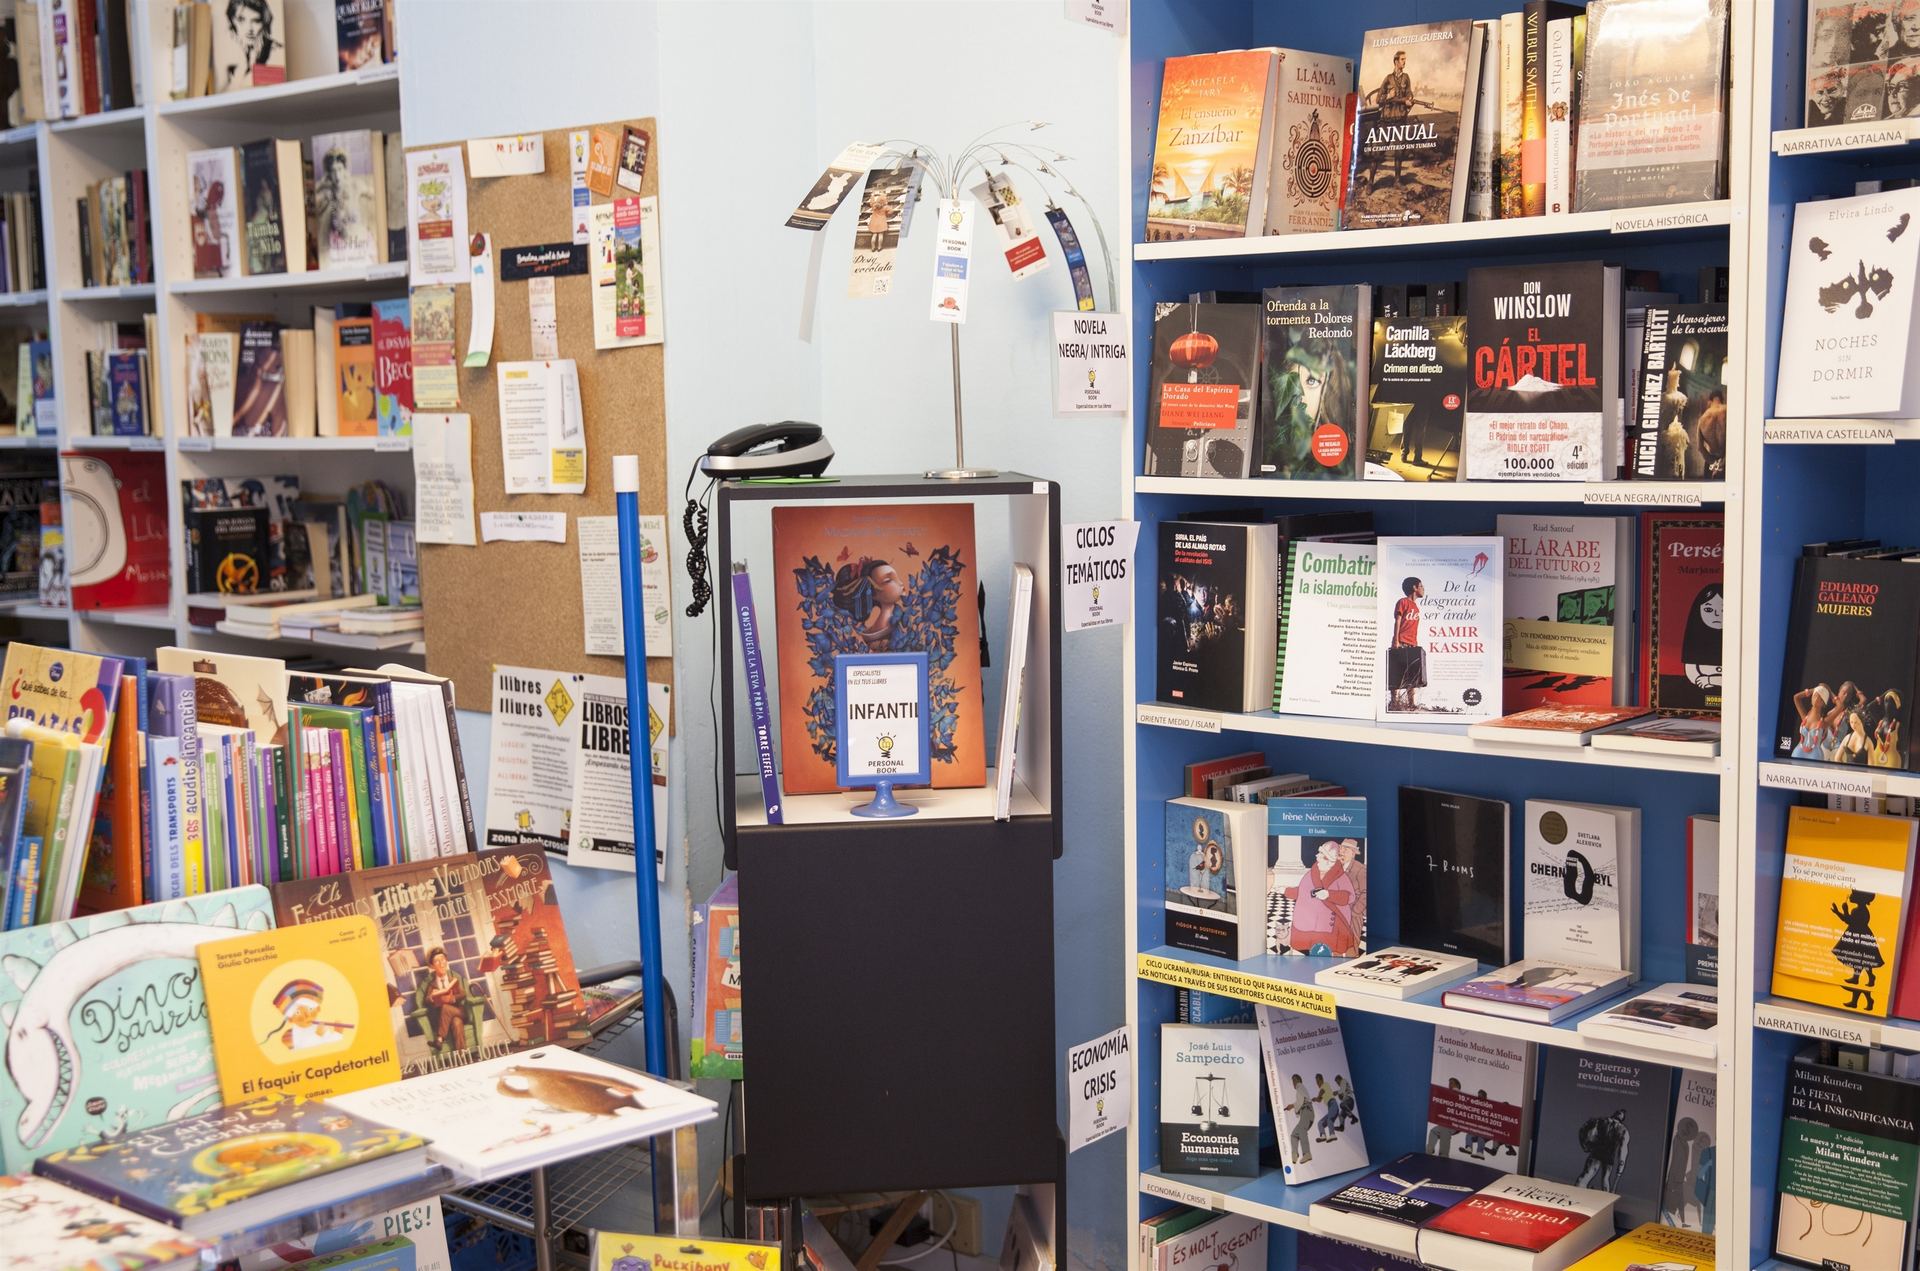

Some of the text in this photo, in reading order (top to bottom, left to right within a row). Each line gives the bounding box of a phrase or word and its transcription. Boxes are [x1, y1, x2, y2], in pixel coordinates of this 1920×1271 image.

[1297, 67, 1336, 86] LLAMA
[1169, 123, 1244, 147] Zanzíbar
[1365, 122, 1438, 145] ANNUAL
[1783, 130, 1902, 153] NARRATIVA CATALANA
[1828, 203, 1894, 221] Elvira Lindo
[1615, 213, 1709, 231] NOVELA HISTÓRICA
[1523, 281, 1541, 295] DON
[1267, 299, 1307, 313] Ofrenda
[1319, 299, 1329, 310] la
[1493, 293, 1572, 320] WINSLOW
[1074, 319, 1107, 335] NOVELA
[1267, 312, 1353, 326] tormenta Dolores
[1672, 313, 1726, 326] Mensajeros
[1308, 327, 1353, 339] Redondo
[1386, 325, 1430, 341] Camilla
[1528, 327, 1541, 342] EL
[1058, 342, 1126, 360] NEGRA/ INTRIGA
[1385, 343, 1436, 361] Läckberg
[1815, 334, 1878, 352] NOCHES
[1383, 363, 1443, 374] Crimen en directo
[1475, 338, 1597, 389] CÁRTEL
[1812, 366, 1874, 382] DORMIR
[1163, 385, 1233, 395] La Casa del Espíritu
[1637, 308, 1669, 476] ALICIA GIMÉNEZ BARTLETT
[1764, 429, 1893, 441] NARRATIVA CASTELLANA
[1503, 458, 1555, 470] 100.000
[1566, 460, 1588, 470] edición
[1584, 492, 1700, 504] NOVELA NEGRA/INTRIGA
[1076, 526, 1115, 549] CICLOS
[1509, 536, 1600, 559] EL ÁRABE
[1066, 555, 1127, 586] TEMÁTICOS
[1302, 551, 1376, 576] Combatir
[1509, 557, 1601, 573] DEL FUTURO 2
[1443, 580, 1476, 593] De la
[1820, 581, 1879, 595] EDUARDO
[1420, 595, 1476, 610] desgracia
[1818, 592, 1876, 605] GALEANO
[1405, 609, 1477, 621] de ser árabe
[1817, 603, 1873, 617] MUJERES
[1429, 626, 1478, 638] SAMIR
[1429, 642, 1485, 653] KASSIR
[500, 675, 542, 695] llibres
[741, 606, 773, 779] CONSTRUEIX LA TEVA PRÒPIA TORRE EIFFEL
[500, 698, 543, 718] lliures
[582, 701, 630, 727] LIBROS
[180, 690, 200, 842] 365 acudits infantils
[1766, 773, 1871, 794] NARRATIVA LATINOAM
[166, 776, 180, 870] DELS TRANSPORTS
[1282, 811, 1354, 825] Irène Némirovsky
[1577, 832, 1601, 841] SVETLANA
[1792, 866, 1802, 874] Yo
[1803, 868, 1811, 876] sé
[1823, 872, 1836, 880] qué
[1837, 875, 1856, 883] canta
[371, 877, 438, 919] Llibres
[433, 854, 502, 897] VOLADORS
[1146, 959, 1324, 1001] CICLO UCRANIA/RUSIA: ENTIENDE LO QUE PASA MÁS ALLÁ DE
[1138, 967, 1149, 977] LAS
[1150, 970, 1178, 983] NOTICIAS
[1183, 976, 1206, 988] TRAVÉS
[1207, 981, 1216, 990] DE
[1216, 983, 1228, 992] SUS
[1228, 985, 1266, 1000] ESCRITORES
[1265, 991, 1295, 1006] CLÁSICOS
[1295, 999, 1301, 1007] Y
[1301, 1000, 1333, 1014] ACTUALES
[80, 966, 199, 1044] Dino
[1758, 1015, 1862, 1043] NARRATIVA INGLESA
[1072, 1030, 1129, 1073] ECONOMÍA
[1188, 1041, 1232, 1052] José Luis
[1438, 1034, 1522, 1062] Antonio Muñoz Molina
[415, 1047, 476, 1074] WILLIAM
[477, 1039, 514, 1062] JOYCE
[1176, 1052, 1245, 1066] Sampedro
[241, 1049, 390, 1094] El faquir Capdetortell
[1578, 1058, 1641, 1077] De guerras y
[1084, 1070, 1117, 1100] CRISIS
[1577, 1071, 1641, 1088] revoluciones
[1795, 1069, 1863, 1091] Milan Kundera
[1793, 1085, 1842, 1103] LA FIESTA
[1792, 1097, 1914, 1131] DE LA INSIGNIFICANCIA
[1181, 1131, 1239, 1145] Economía
[1800, 1134, 1809, 1142] La
[1810, 1137, 1829, 1147] nueva
[1835, 1142, 1865, 1155] esperada
[1866, 1149, 1889, 1160] novela
[1890, 1152, 1899, 1160] de
[1180, 1143, 1240, 1156] humanista
[1815, 1145, 1881, 1168] Milan Kundera
[1501, 1186, 1582, 1207] Piketty
[1467, 1199, 1570, 1226] El capital
[383, 1205, 431, 1239] PIES!
[1212, 1222, 1264, 1261] URGENT!
[653, 1254, 731, 1271] Putxibany
